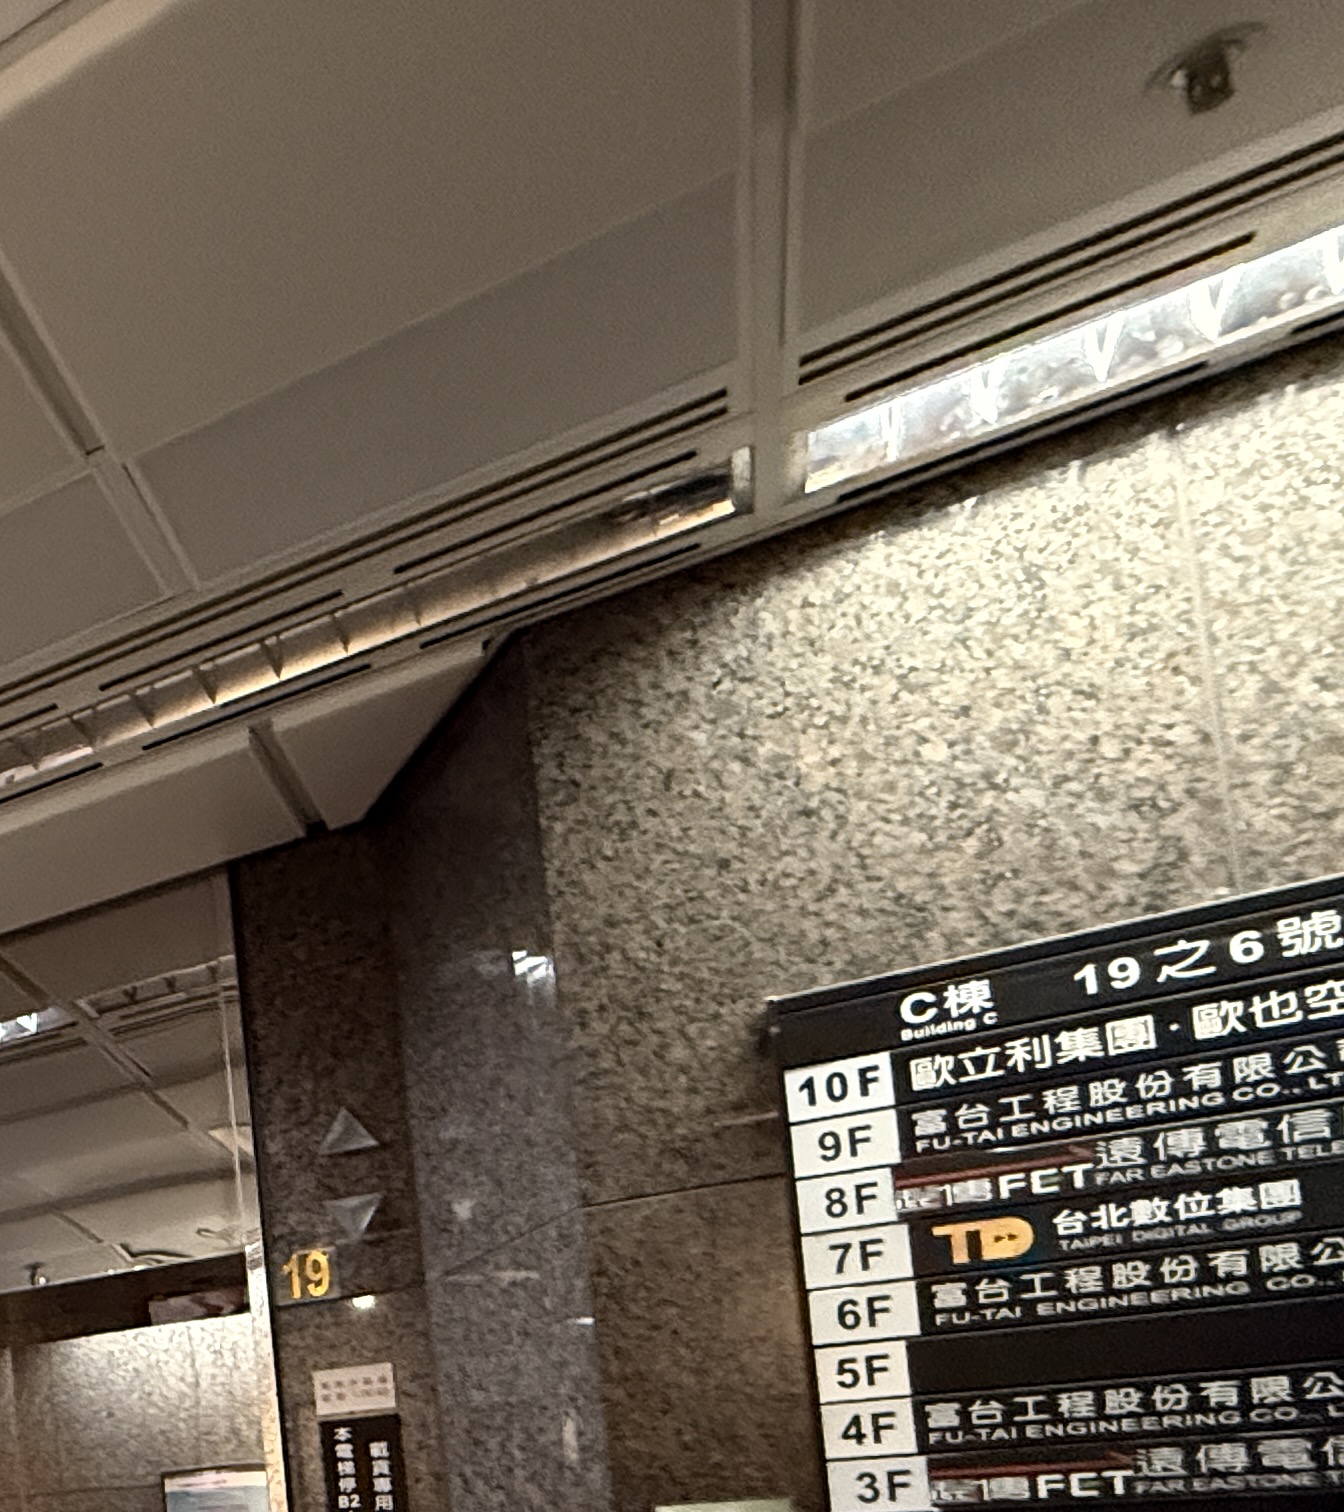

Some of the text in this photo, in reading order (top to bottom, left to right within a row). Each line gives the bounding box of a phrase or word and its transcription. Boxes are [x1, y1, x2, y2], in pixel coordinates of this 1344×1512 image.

[900, 979, 995, 1026] C棟
[901, 1011, 999, 1041] Building C
[798, 1068, 882, 1109] 10F
[912, 1039, 1344, 1138] 富台工程股份有限公
[915, 1126, 1003, 1154] FU-TAI
[1012, 1091, 1225, 1140] ENGINEERING
[817, 1125, 874, 1162] 9F
[1096, 1168, 1144, 1187] FAR
[1151, 1150, 1274, 1183] EASTONE
[824, 1182, 879, 1218] 8F
[1052, 1179, 1304, 1238] 台北數位集團
[1060, 1210, 1304, 1252] TAIPEI DIGITAL GROUP
[282, 1250, 329, 1298] 19
[830, 1238, 885, 1275] 7F
[836, 1295, 892, 1331] 6F
[935, 1306, 1022, 1327] FU-TAI
[1037, 1280, 1251, 1318] ENGINEERING
[836, 1352, 890, 1388] 5F
[841, 1409, 897, 1445] 4F
[929, 1425, 1017, 1445] FU-TAI
[1024, 1408, 1241, 1440] ENGINEERING
[856, 1468, 912, 1504] 3F
